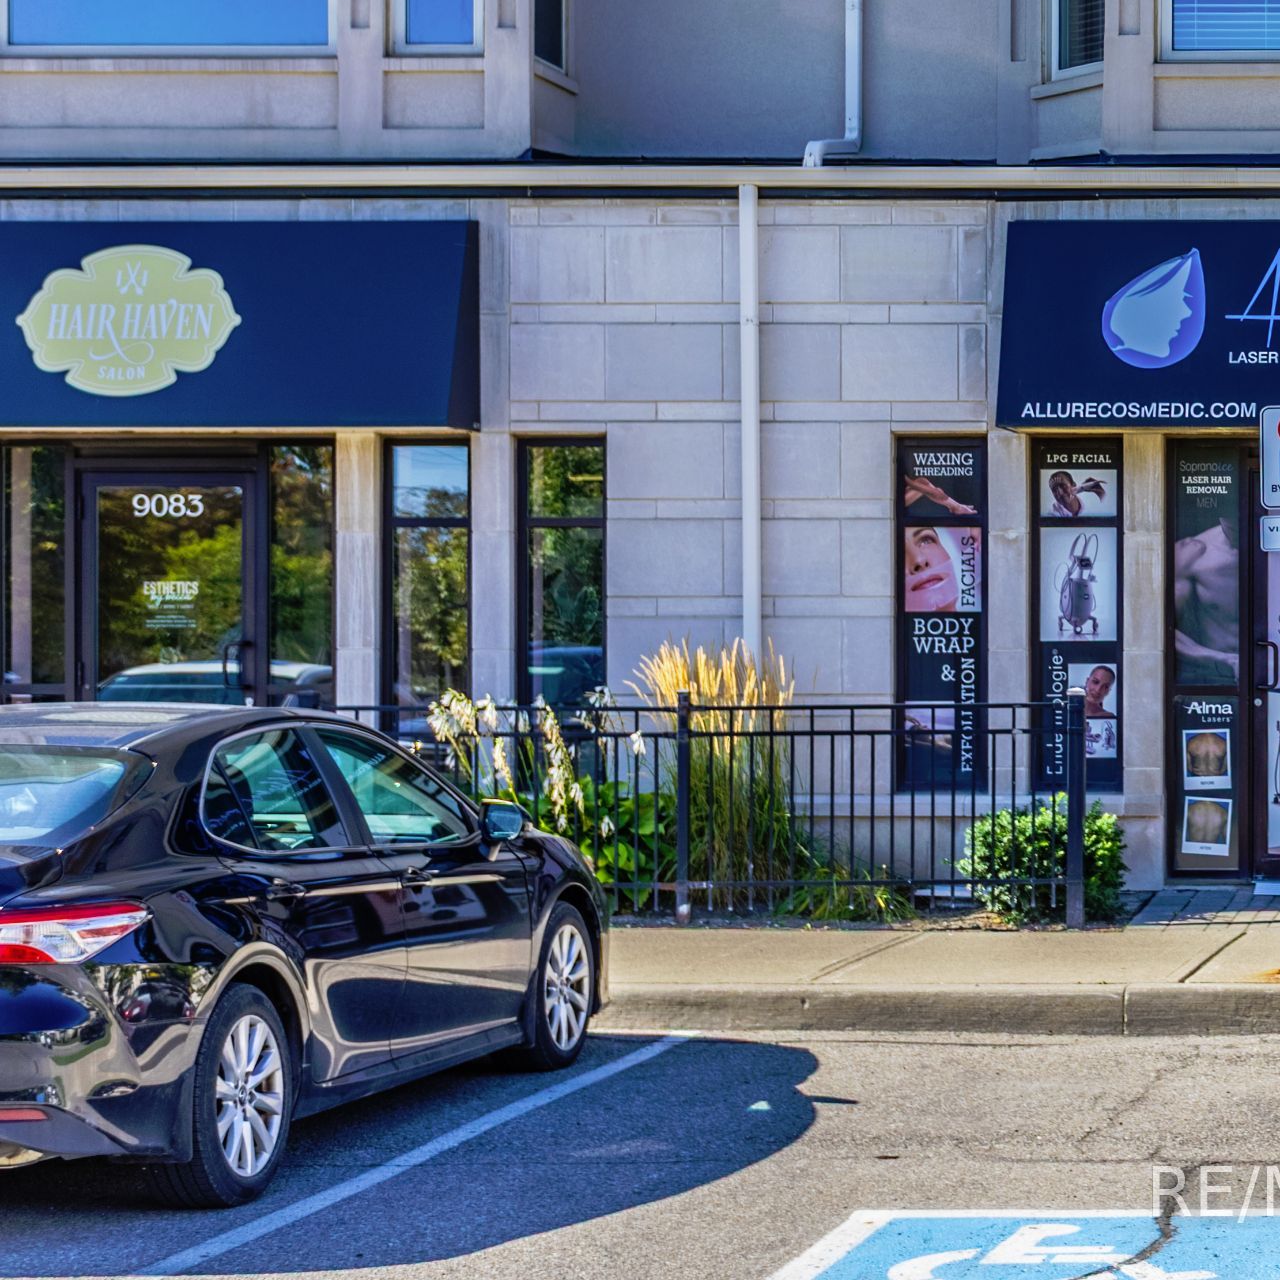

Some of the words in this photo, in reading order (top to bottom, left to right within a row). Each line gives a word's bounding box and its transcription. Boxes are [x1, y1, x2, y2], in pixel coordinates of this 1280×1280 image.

[47, 303, 122, 365] HAIR
[121, 298, 214, 340] HAVEN
[1228, 352, 1279, 365] LASER
[97, 366, 146, 382] SALON
[1021, 402, 1257, 419] ALLURECOSMEDIC.COM
[913, 453, 974, 466] WAXING
[1046, 454, 1068, 463] LPG
[1072, 454, 1112, 463] FACIAL
[914, 467, 974, 477] THREADING
[1182, 476, 1209, 484] LASER
[1211, 476, 1232, 484] HAIR
[1186, 486, 1228, 494] REMOVAL
[132, 493, 205, 518] 9083
[1196, 497, 1218, 509] MEN
[961, 535, 976, 607] FACIALS
[143, 581, 199, 595] ESTHETICS
[913, 618, 974, 635] BODY
[912, 636, 975, 654] WRAP
[941, 664, 956, 682] &
[1184, 702, 1233, 715] Alma
